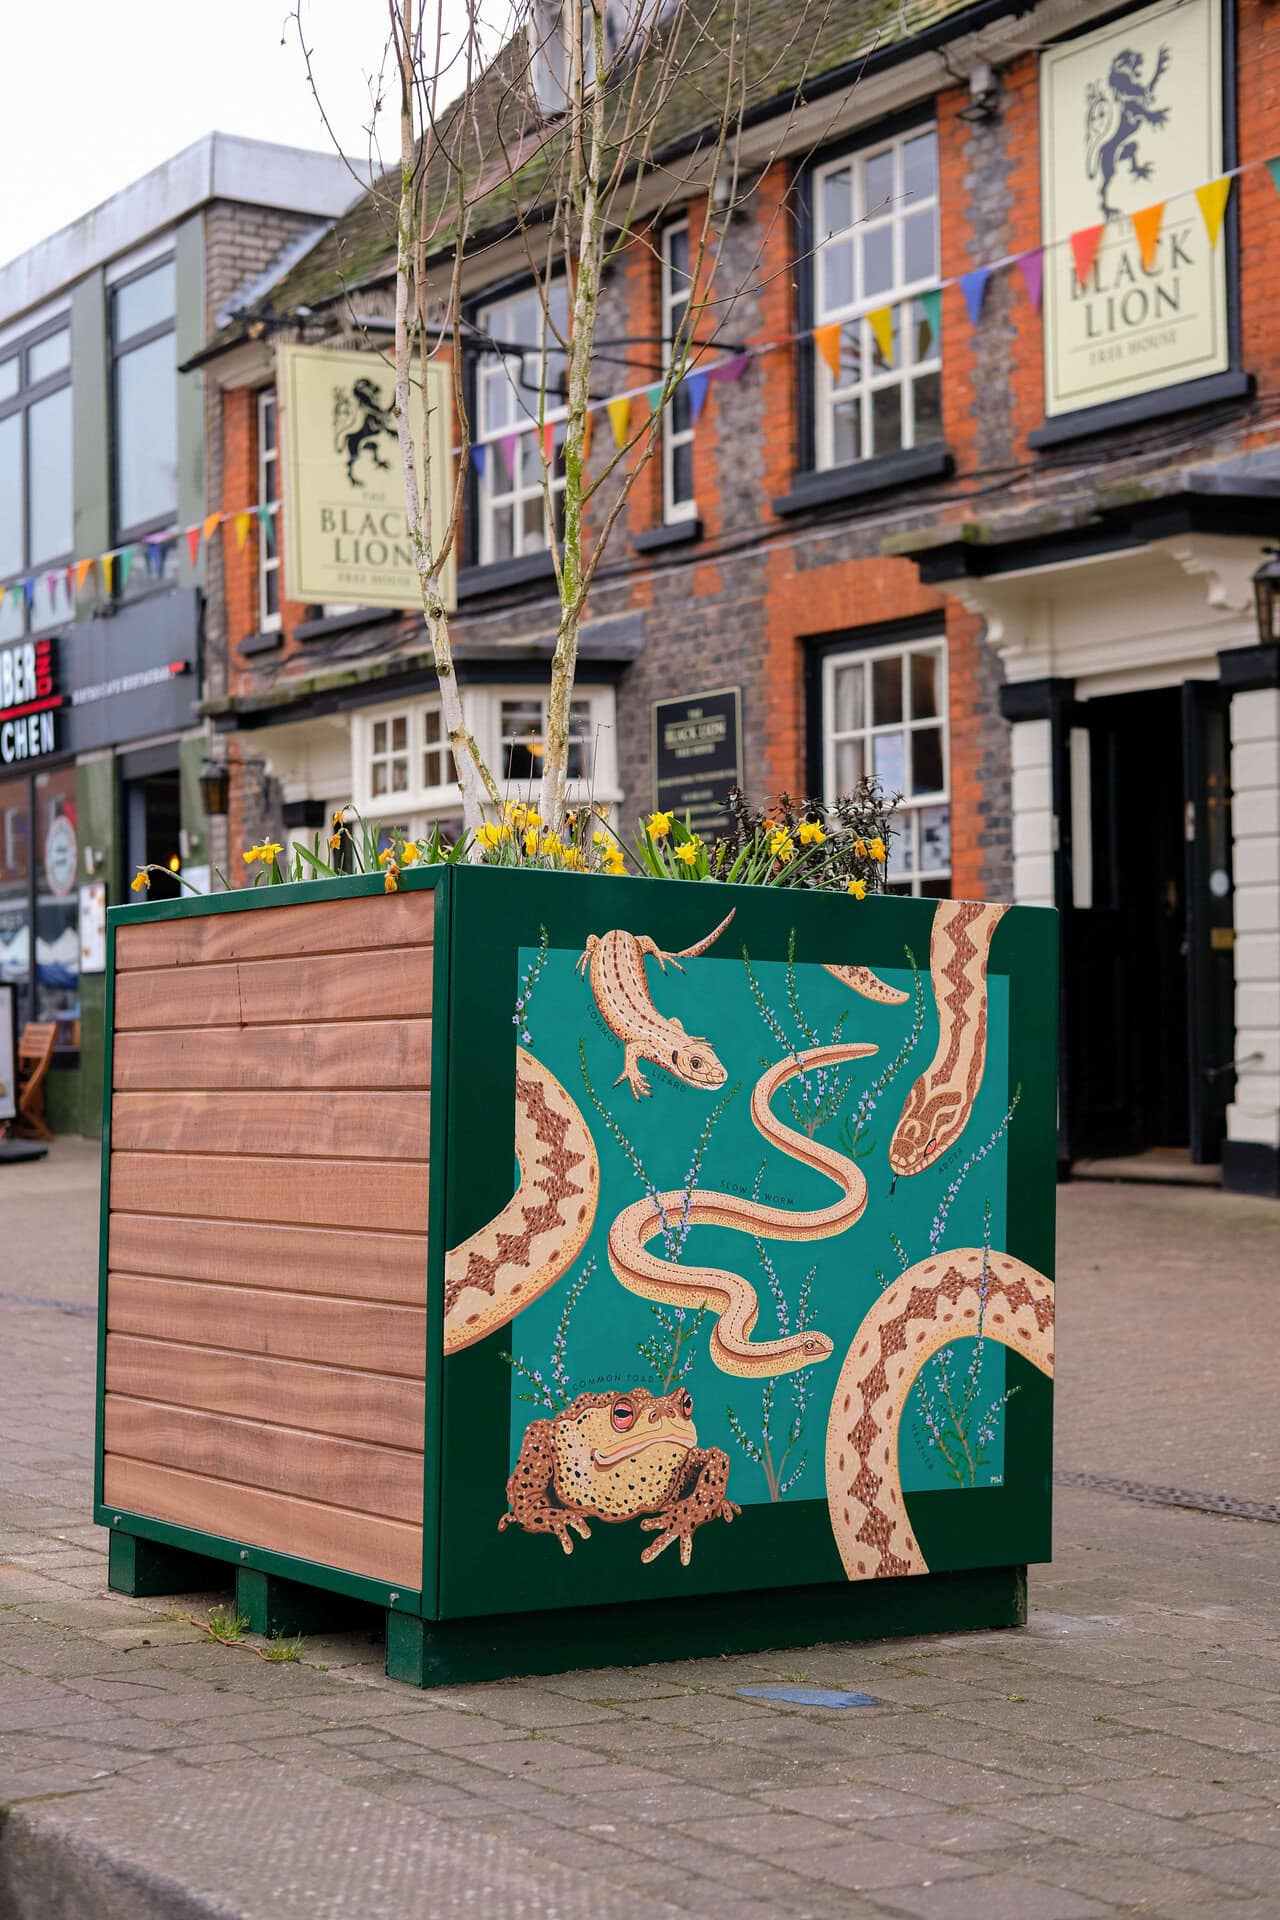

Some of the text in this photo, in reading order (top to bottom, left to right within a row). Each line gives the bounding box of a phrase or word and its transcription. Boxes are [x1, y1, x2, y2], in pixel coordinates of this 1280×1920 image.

[1085, 277, 1181, 339] LION
[1089, 328, 1178, 367] FREE HOUSE
[321, 507, 410, 540] BLAC
[334, 538, 414, 567] LION
[0, 643, 36, 709] BER
[1, 711, 55, 763] CHEN
[587, 1004, 687, 1093] COMMON LIZARD
[938, 1147, 964, 1175] ADDER
[720, 1180, 794, 1206] SLOW WORM
[572, 1374, 655, 1391] COMMON TOAD
